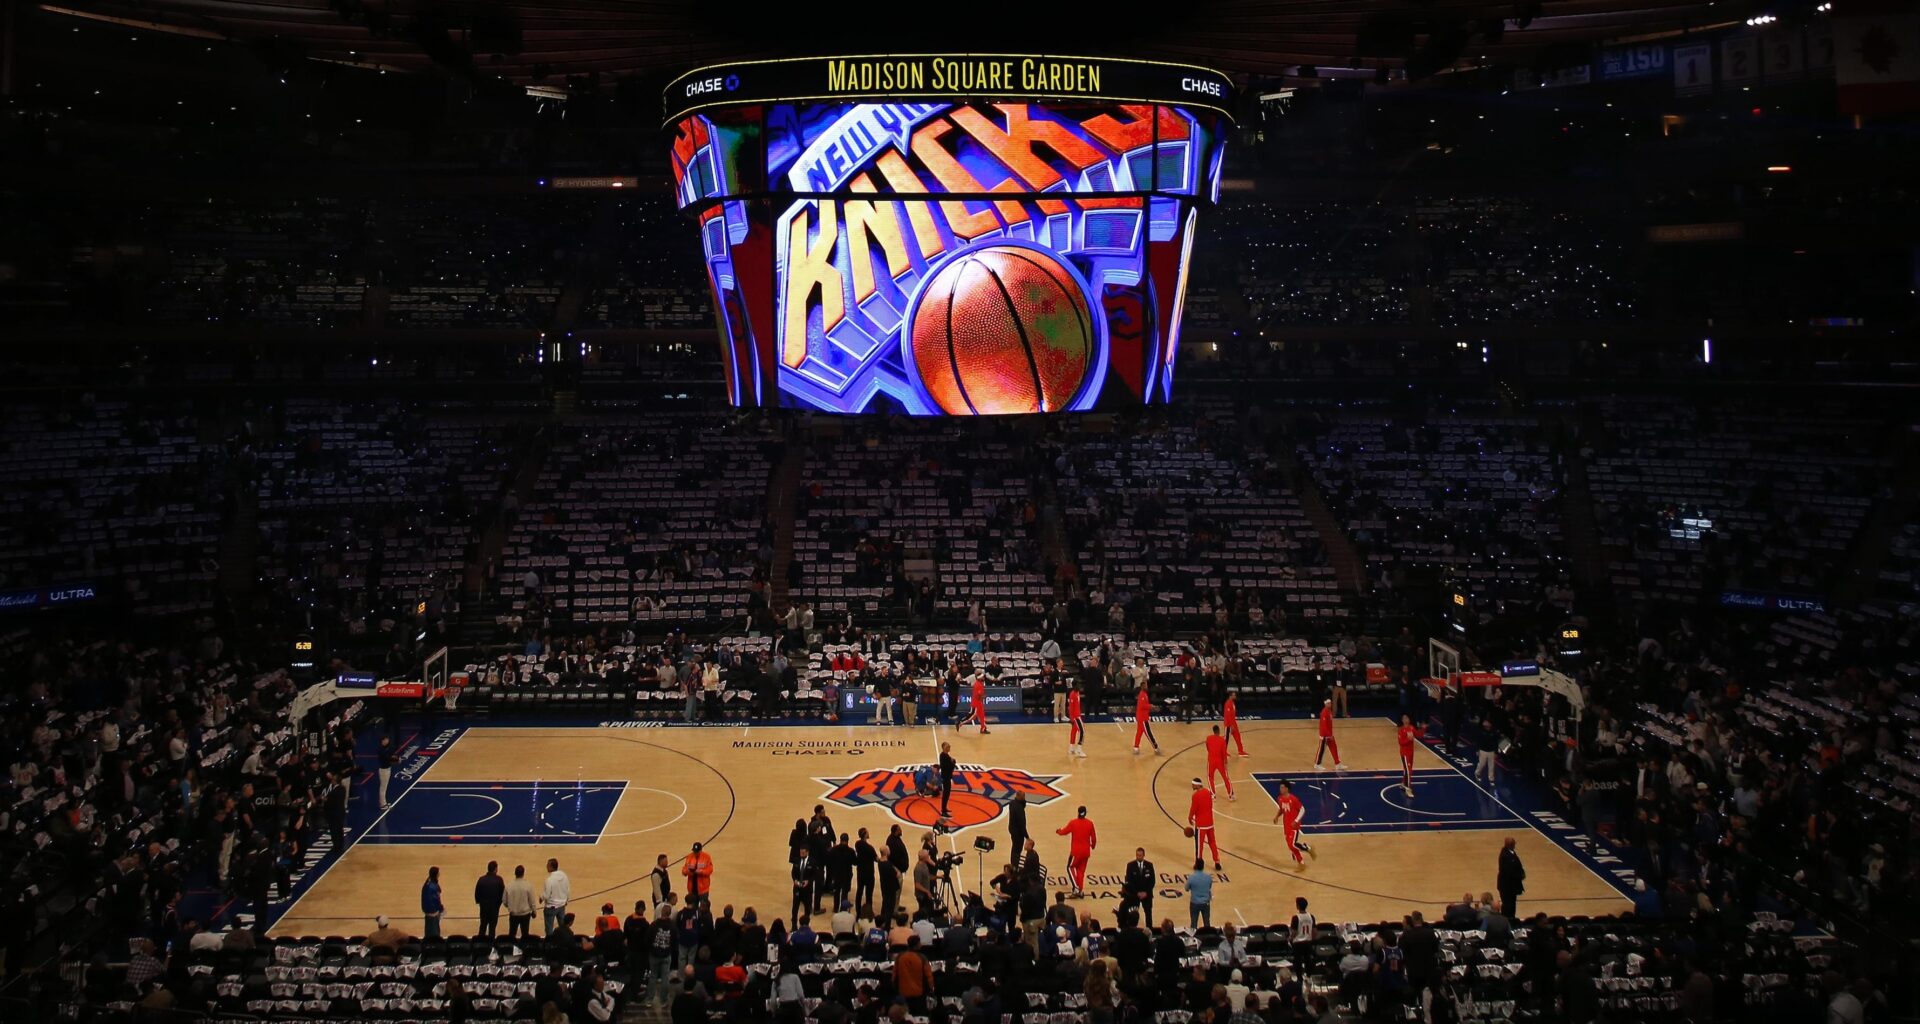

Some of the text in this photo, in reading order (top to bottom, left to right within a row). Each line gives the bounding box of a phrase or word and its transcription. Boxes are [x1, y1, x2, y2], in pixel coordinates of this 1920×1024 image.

[828, 57, 1100, 92] MADISON SQUARE GARDEN
[1687, 59, 1697, 84] 1
[686, 77, 722, 97] CHASE
[1182, 78, 1220, 97] CHASE
[50, 588, 94, 601] ULTRA
[1778, 599, 1824, 611] ULTRA
[985, 694, 1014, 705] peacock
[609, 720, 666, 728] PLAYOFFS
[1124, 716, 1177, 724] PLOFFS
[426, 727, 460, 750] ULTRA
[732, 739, 906, 748] MADISON SQUARE GARDEN
[827, 769, 1064, 799] KNCKS
[1530, 811, 1577, 830] NEW
[1302, 926, 1310, 935] 11
